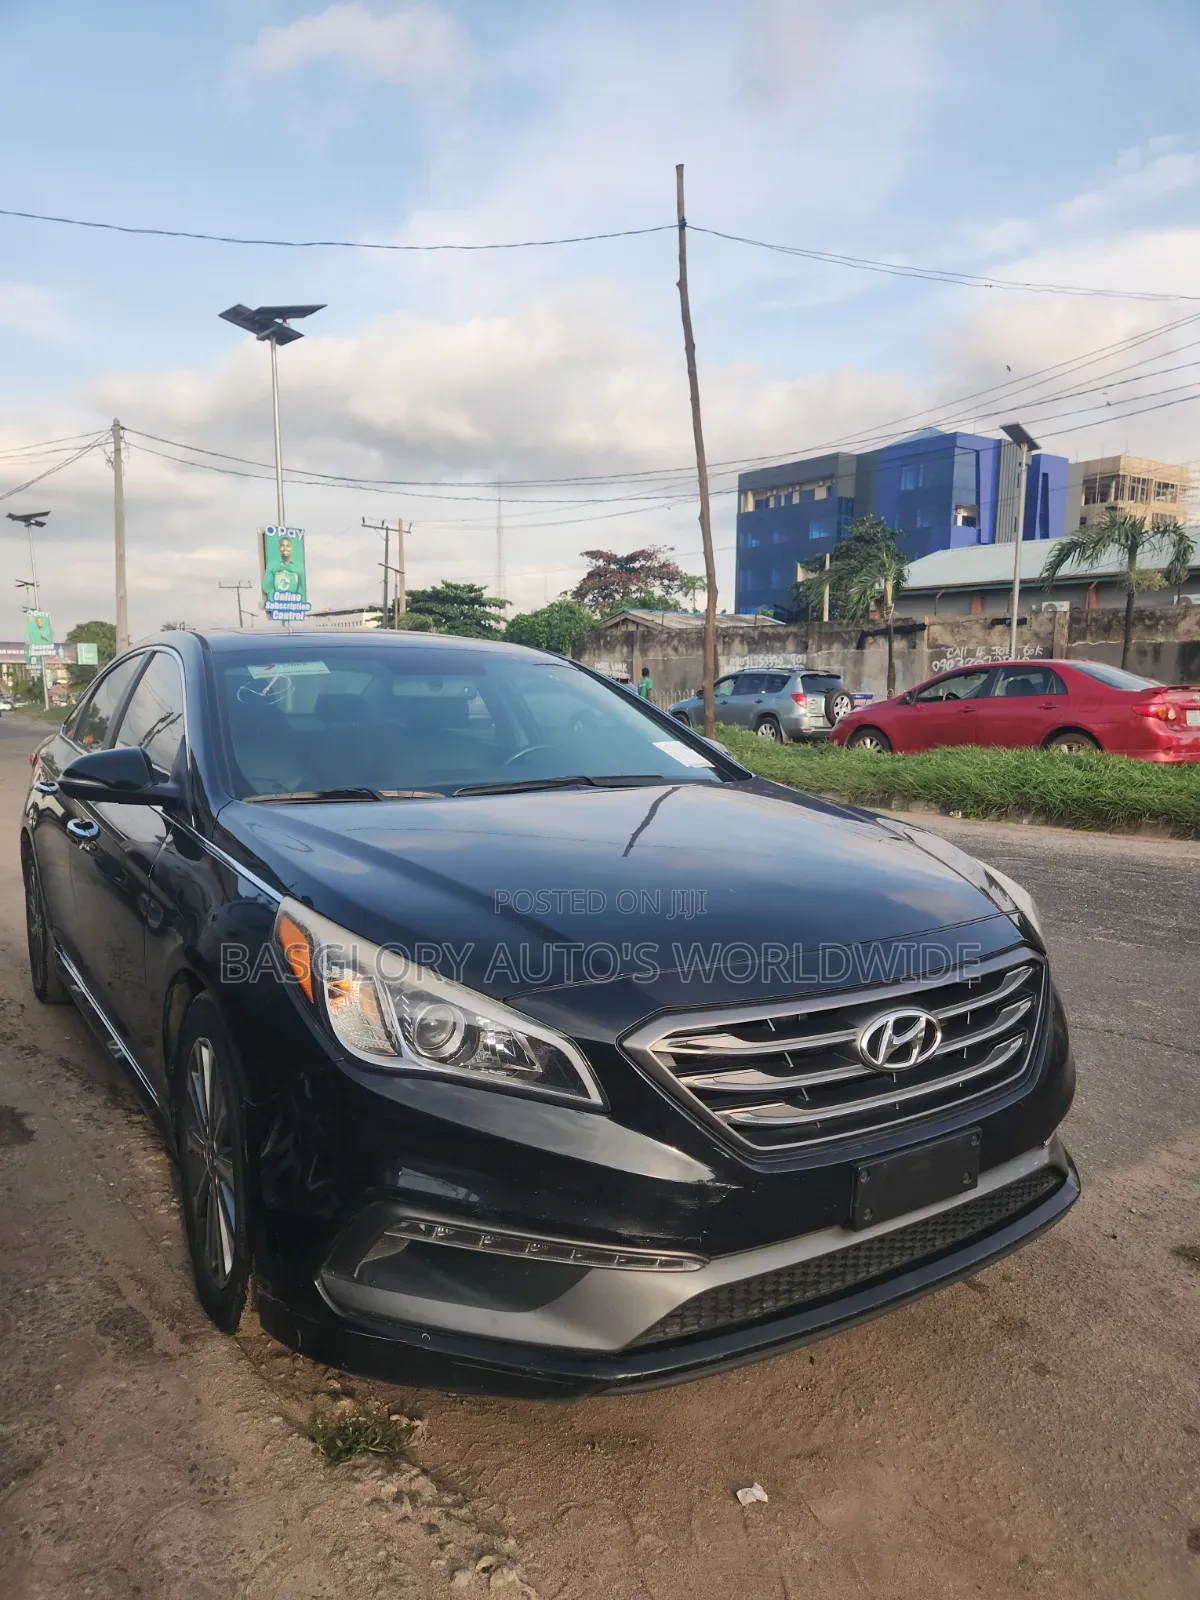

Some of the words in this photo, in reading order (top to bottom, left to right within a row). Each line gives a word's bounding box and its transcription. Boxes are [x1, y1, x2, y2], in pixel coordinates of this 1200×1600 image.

[274, 591, 302, 601] Online
[265, 601, 311, 610] Subscription
[272, 610, 305, 620] Control
